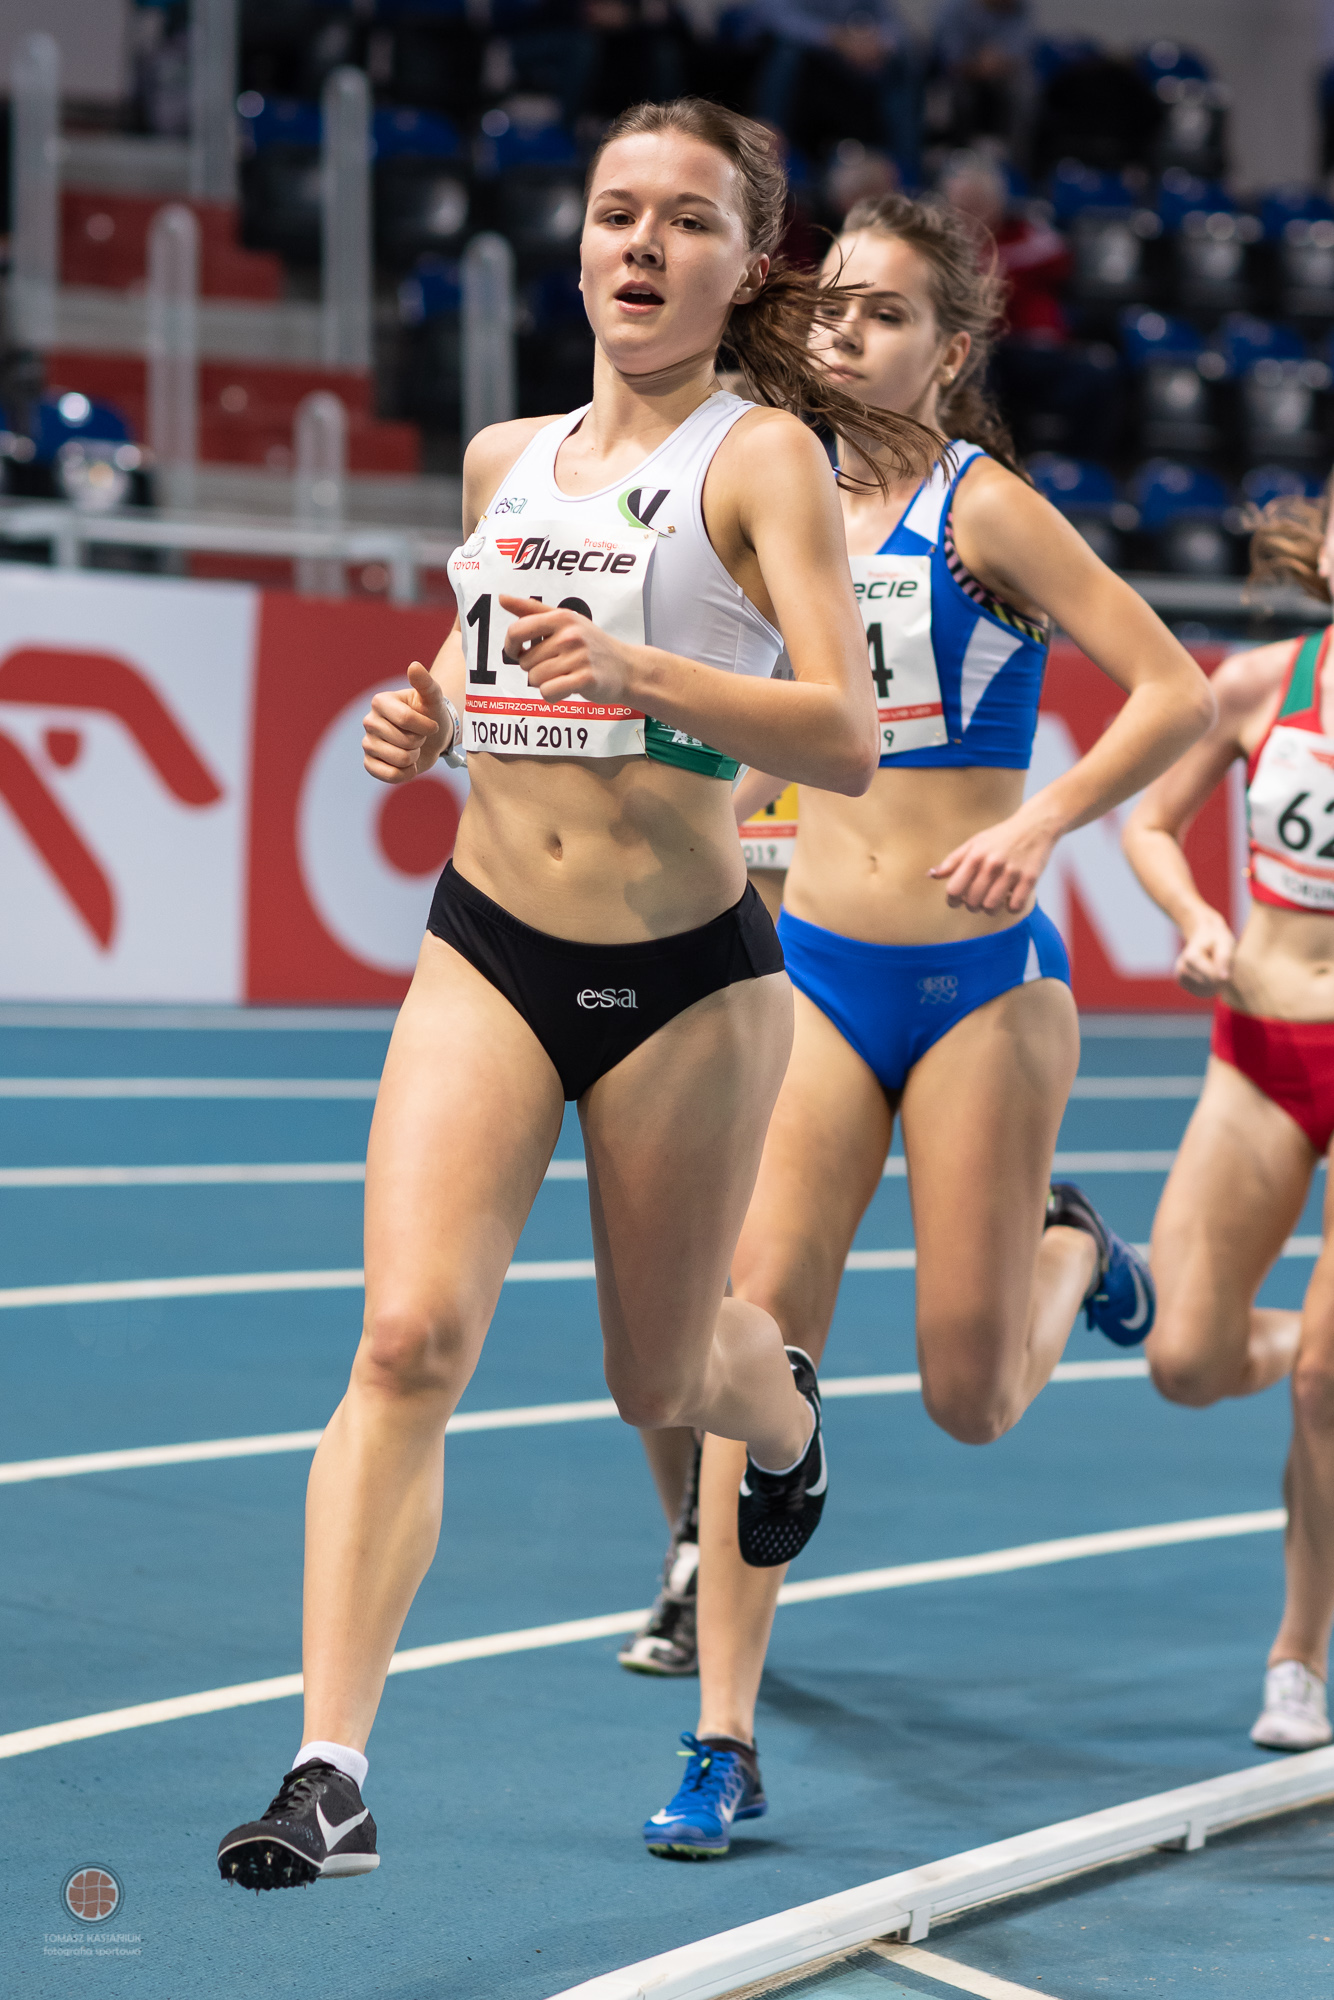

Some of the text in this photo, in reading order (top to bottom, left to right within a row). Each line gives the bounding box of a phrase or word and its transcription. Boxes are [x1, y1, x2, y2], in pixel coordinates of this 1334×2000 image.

[453, 561, 480, 570] TOYOTA
[489, 701, 551, 712] MISTRZOSTWA
[552, 705, 585, 714] POLSKI
[587, 706, 605, 715] U18
[608, 707, 632, 716] U20
[471, 717, 588, 749] TORUŃ 2019
[743, 845, 777, 863] 019
[576, 988, 639, 1009] esa
